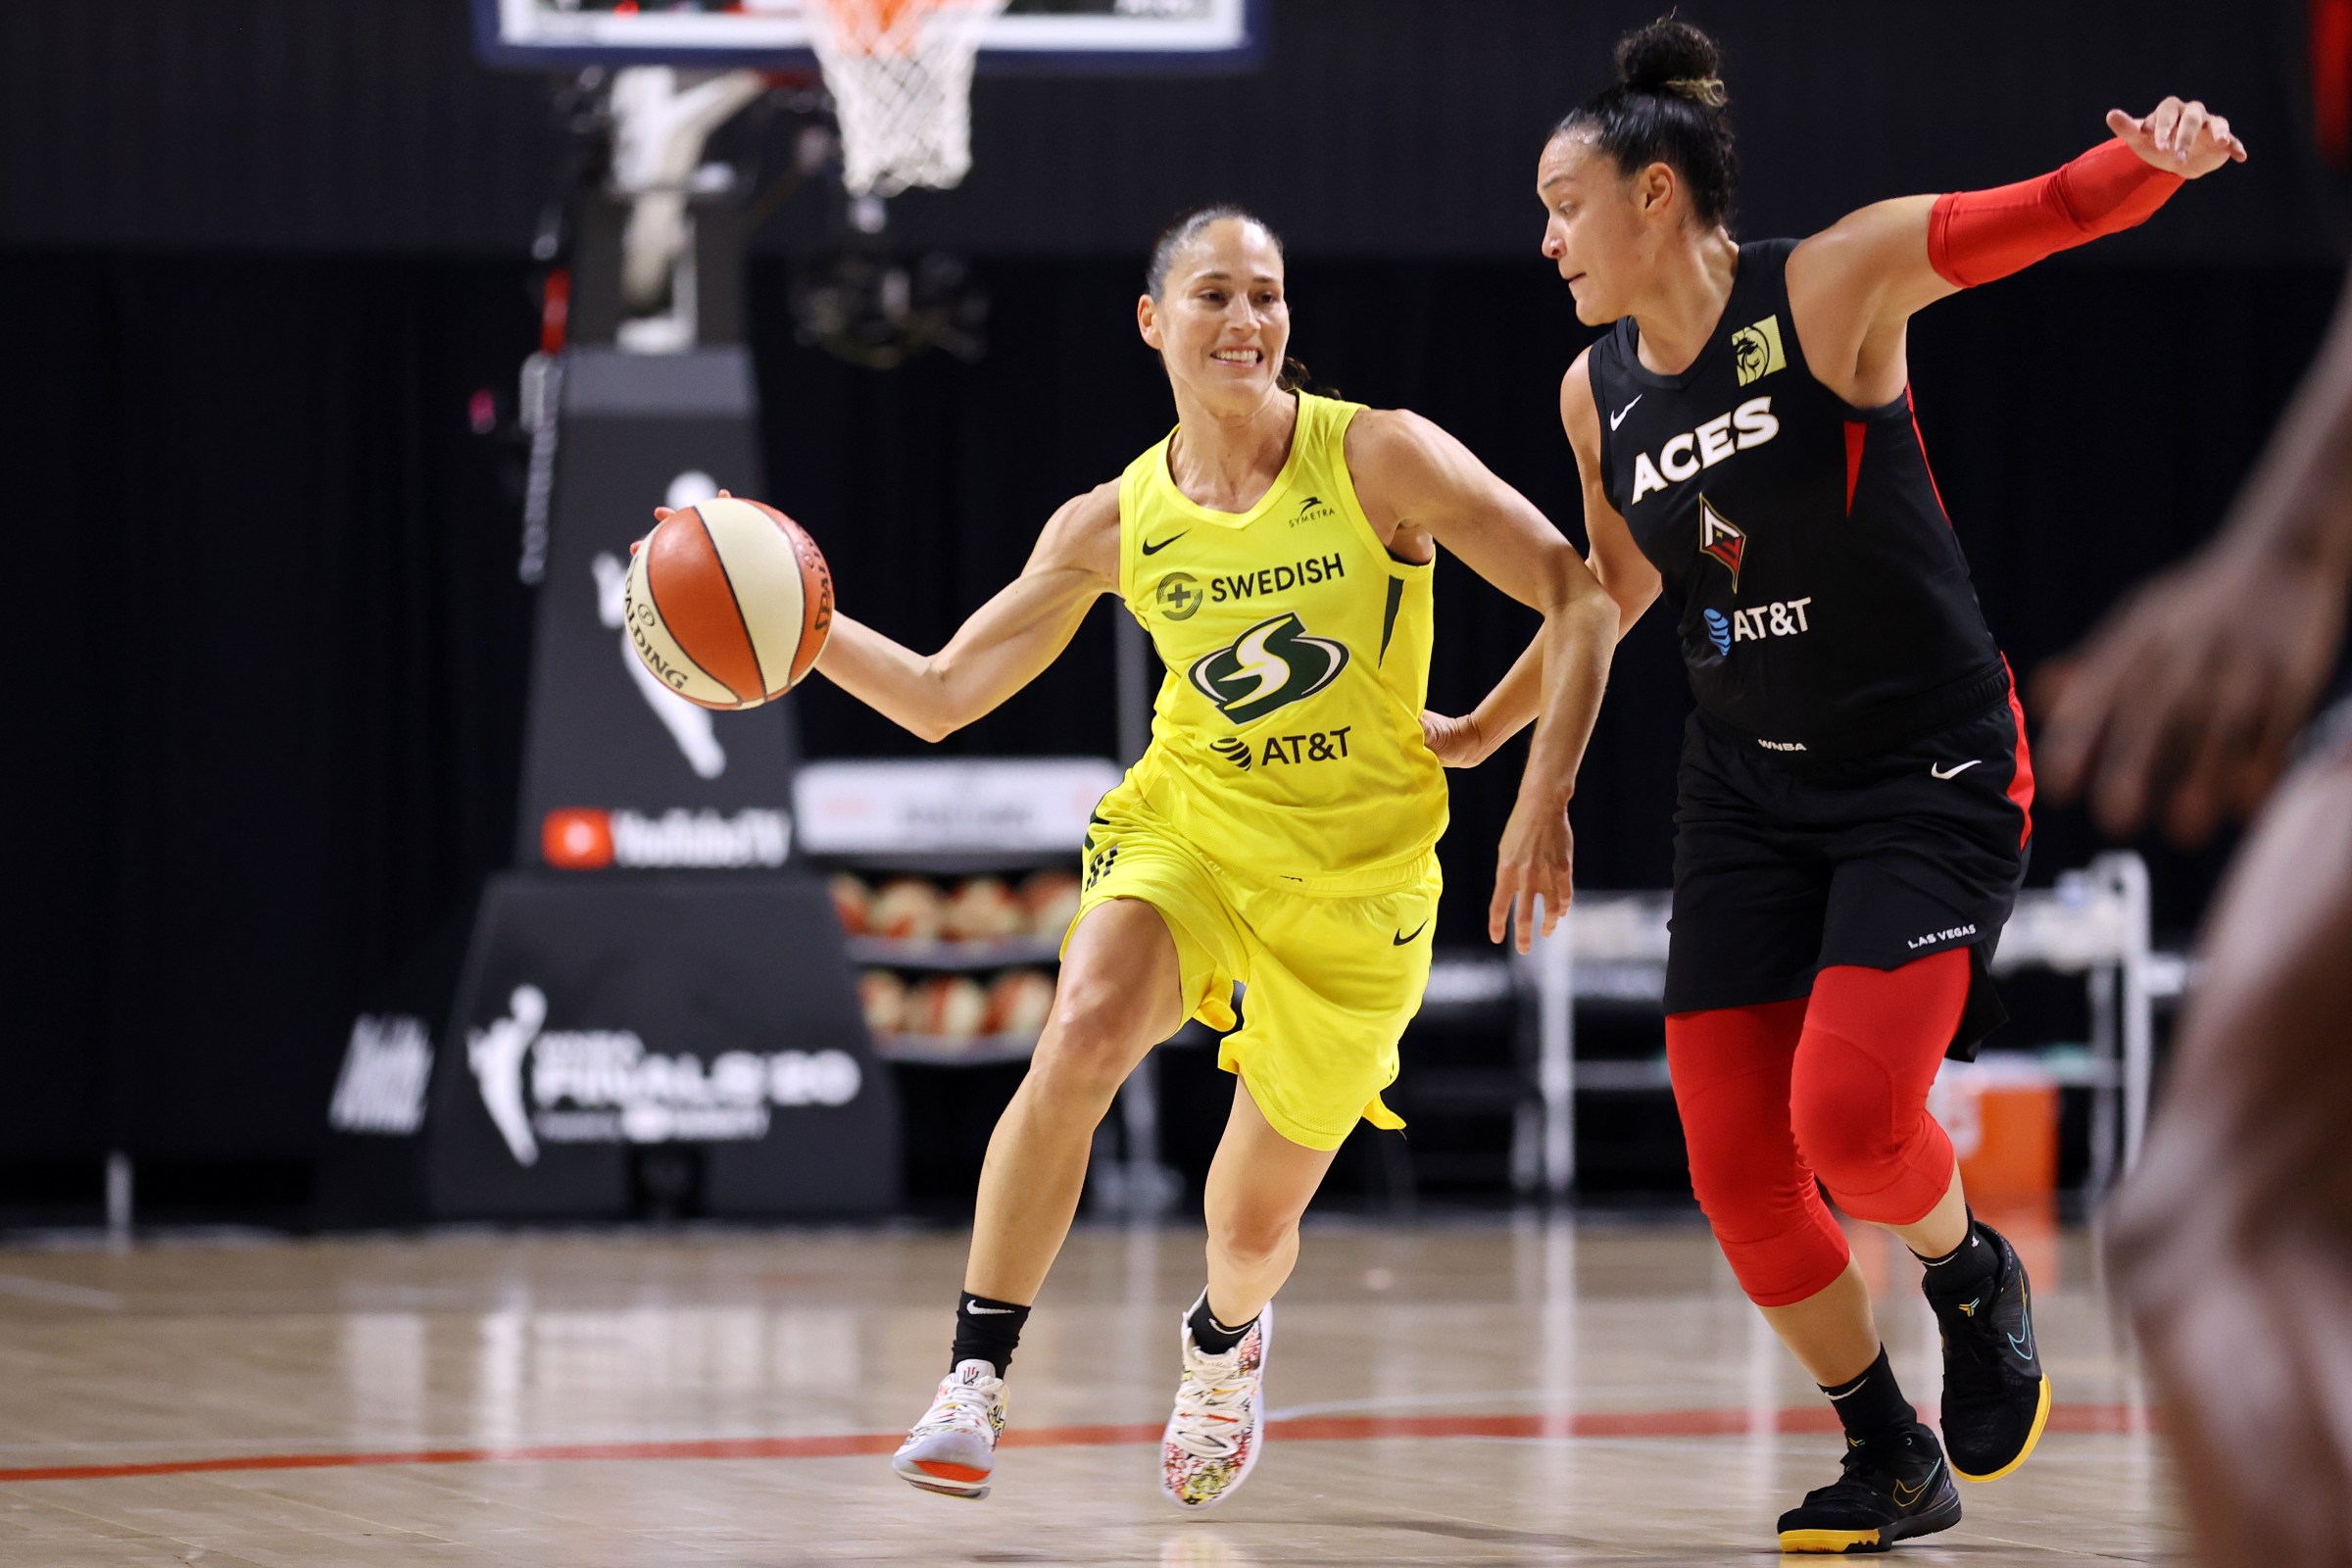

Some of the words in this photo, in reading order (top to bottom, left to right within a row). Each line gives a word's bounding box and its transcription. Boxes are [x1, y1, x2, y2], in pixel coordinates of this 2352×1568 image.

[1631, 396, 1780, 506] ACES
[1289, 508, 1335, 528] SYMETRA
[1211, 553, 1345, 603] SWEDISH
[1734, 597, 1812, 643] AT&T
[1261, 726, 1351, 766] AT&T
[1757, 739, 1807, 751] WNBA
[1907, 934, 1936, 950] LAS
[1936, 923, 1977, 941] VEGAS
